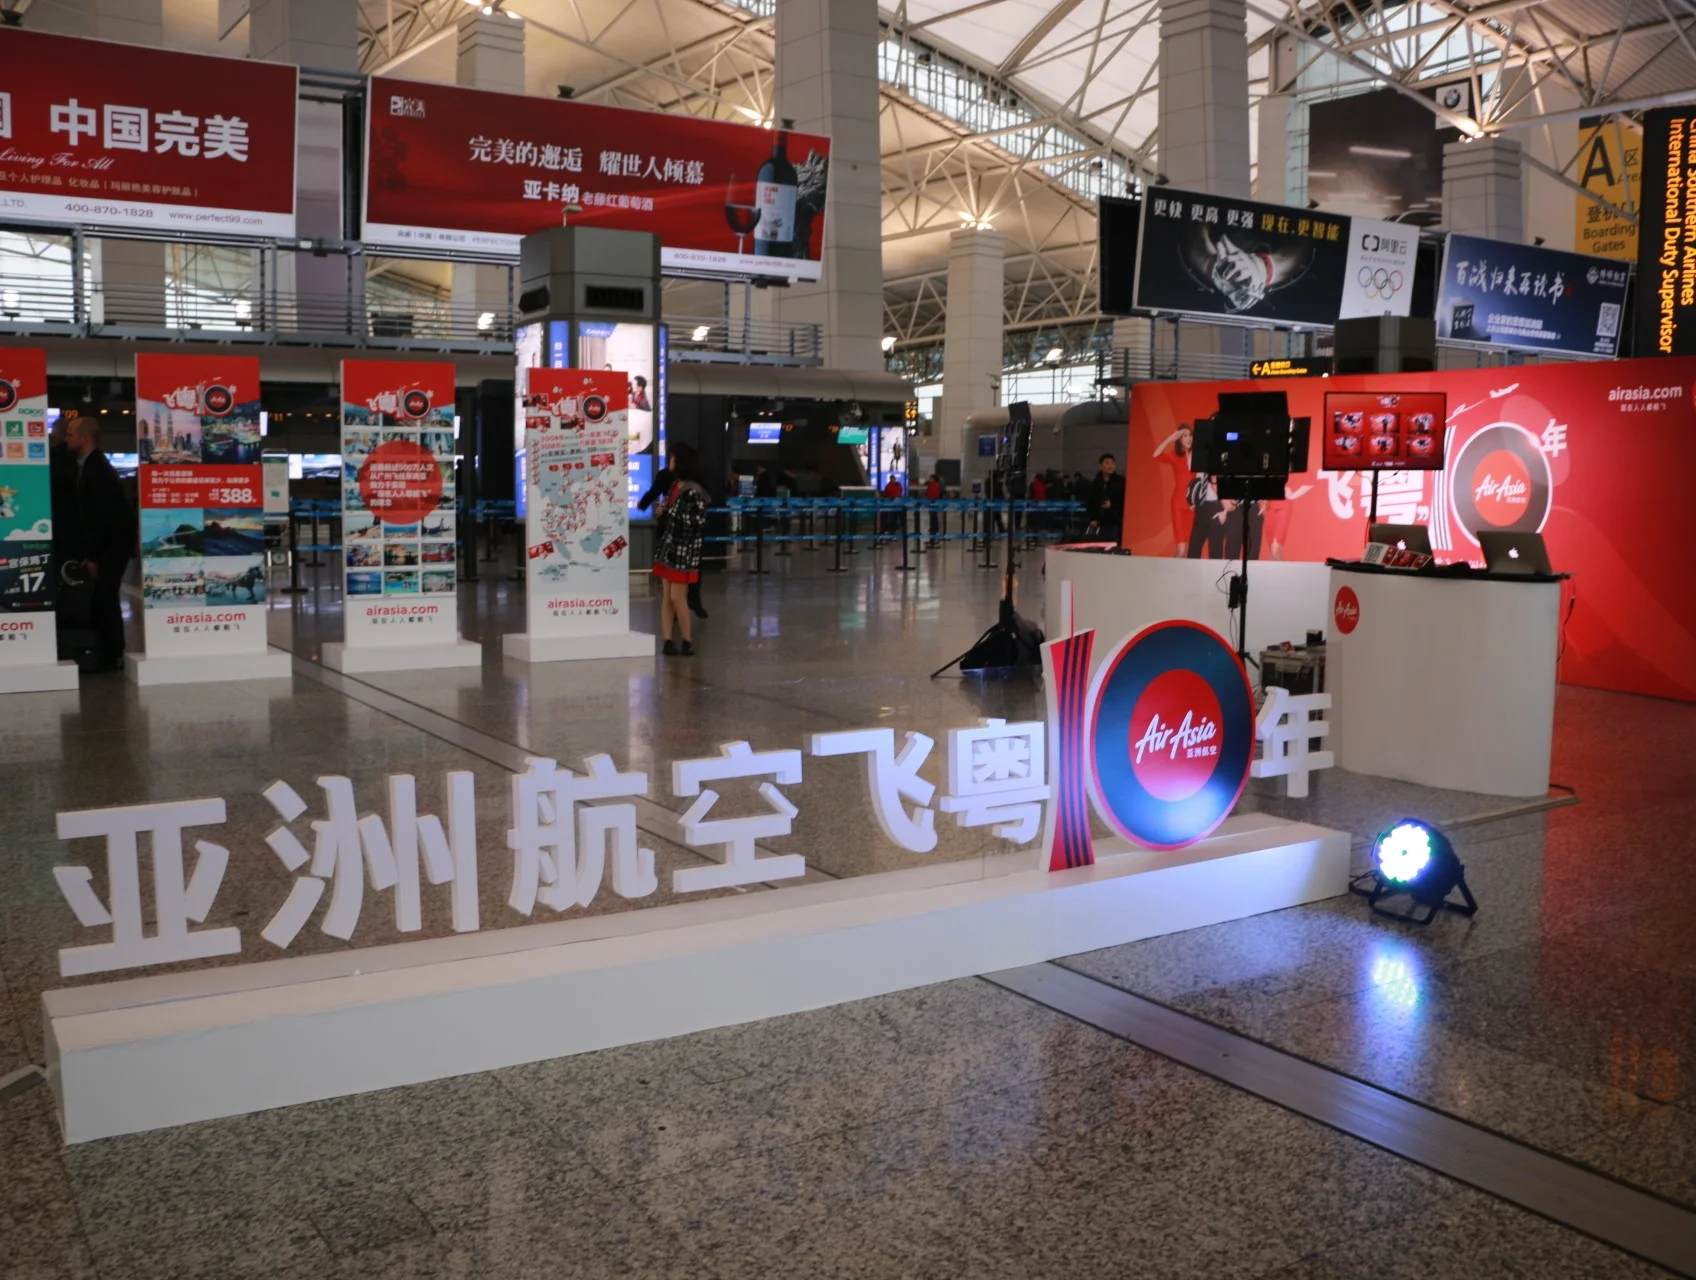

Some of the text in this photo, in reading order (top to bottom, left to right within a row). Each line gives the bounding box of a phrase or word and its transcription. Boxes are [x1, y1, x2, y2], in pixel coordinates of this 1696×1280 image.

[50, 98, 250, 163] 中国完美
[49, 152, 77, 168] For
[82, 156, 115, 171] All
[468, 135, 705, 185] 完美的邂逅 耀世人倾慕
[1581, 135, 1616, 189] A
[523, 179, 579, 203] 亚卡纳
[64, 203, 154, 218] 400-870-1828
[169, 210, 264, 226] www.perfect99.com
[1583, 223, 1637, 240] Boarding
[1657, 117, 1687, 354] International Duty Supervisor
[1592, 238, 1627, 253] Gates
[1608, 385, 1683, 402] airasia.com
[19, 571, 46, 593] 17
[366, 604, 439, 617] airasia.com
[547, 597, 614, 609] airasia.com
[166, 611, 247, 625] airasia.com
[1134, 709, 1218, 765] AirAsia
[1186, 745, 1218, 760] 亚洲航空
